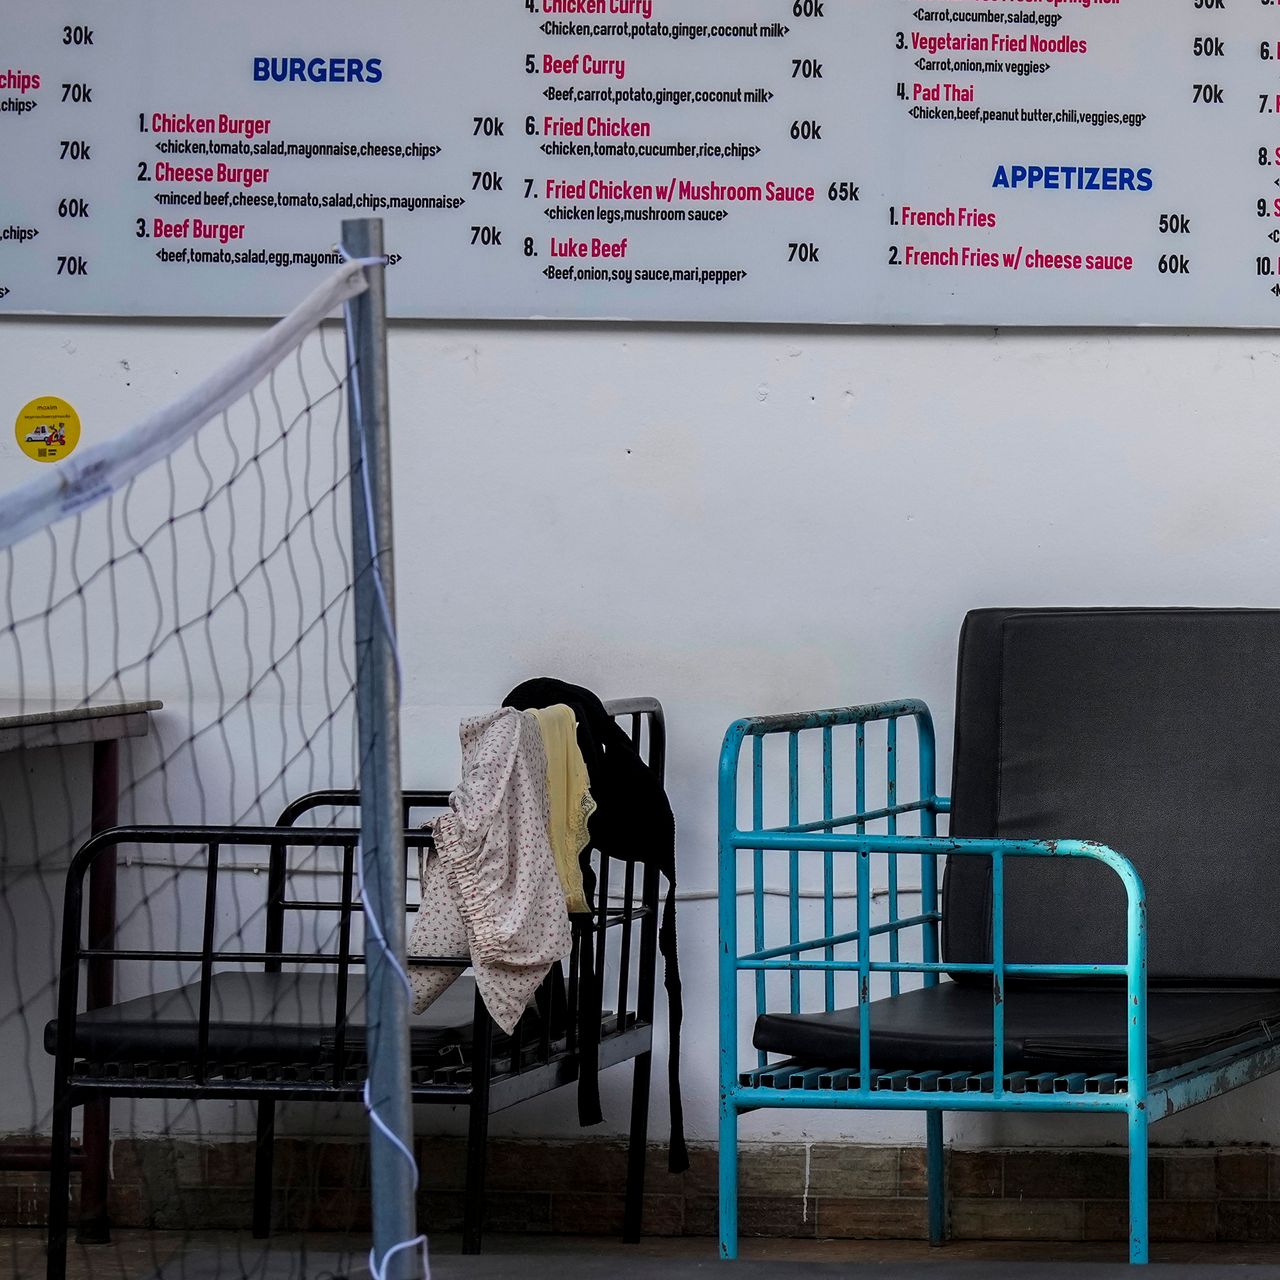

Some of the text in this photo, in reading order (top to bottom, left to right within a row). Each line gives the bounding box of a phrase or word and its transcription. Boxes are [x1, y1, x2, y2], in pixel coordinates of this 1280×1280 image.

[896, 32, 1087, 54] 3. Vegetarian Fried Noodles
[1193, 37, 1224, 56] 50k
[253, 57, 382, 83] BURGERS
[897, 83, 973, 102] 4. Pad Thai
[1193, 84, 1224, 103] 70k
[1259, 95, 1272, 113] 7.
[139, 113, 271, 139] 1. Chicken Burger
[473, 117, 504, 136] 70k
[526, 116, 650, 137] 6. Fried Chicken
[137, 162, 269, 188] 2. Cheese Burger
[472, 172, 503, 191] 70k
[992, 165, 1152, 191] APPETIZERS
[889, 206, 996, 227] 1. French Fries
[1257, 198, 1270, 217] 9.
[524, 237, 627, 257] 8. Luke Beef
